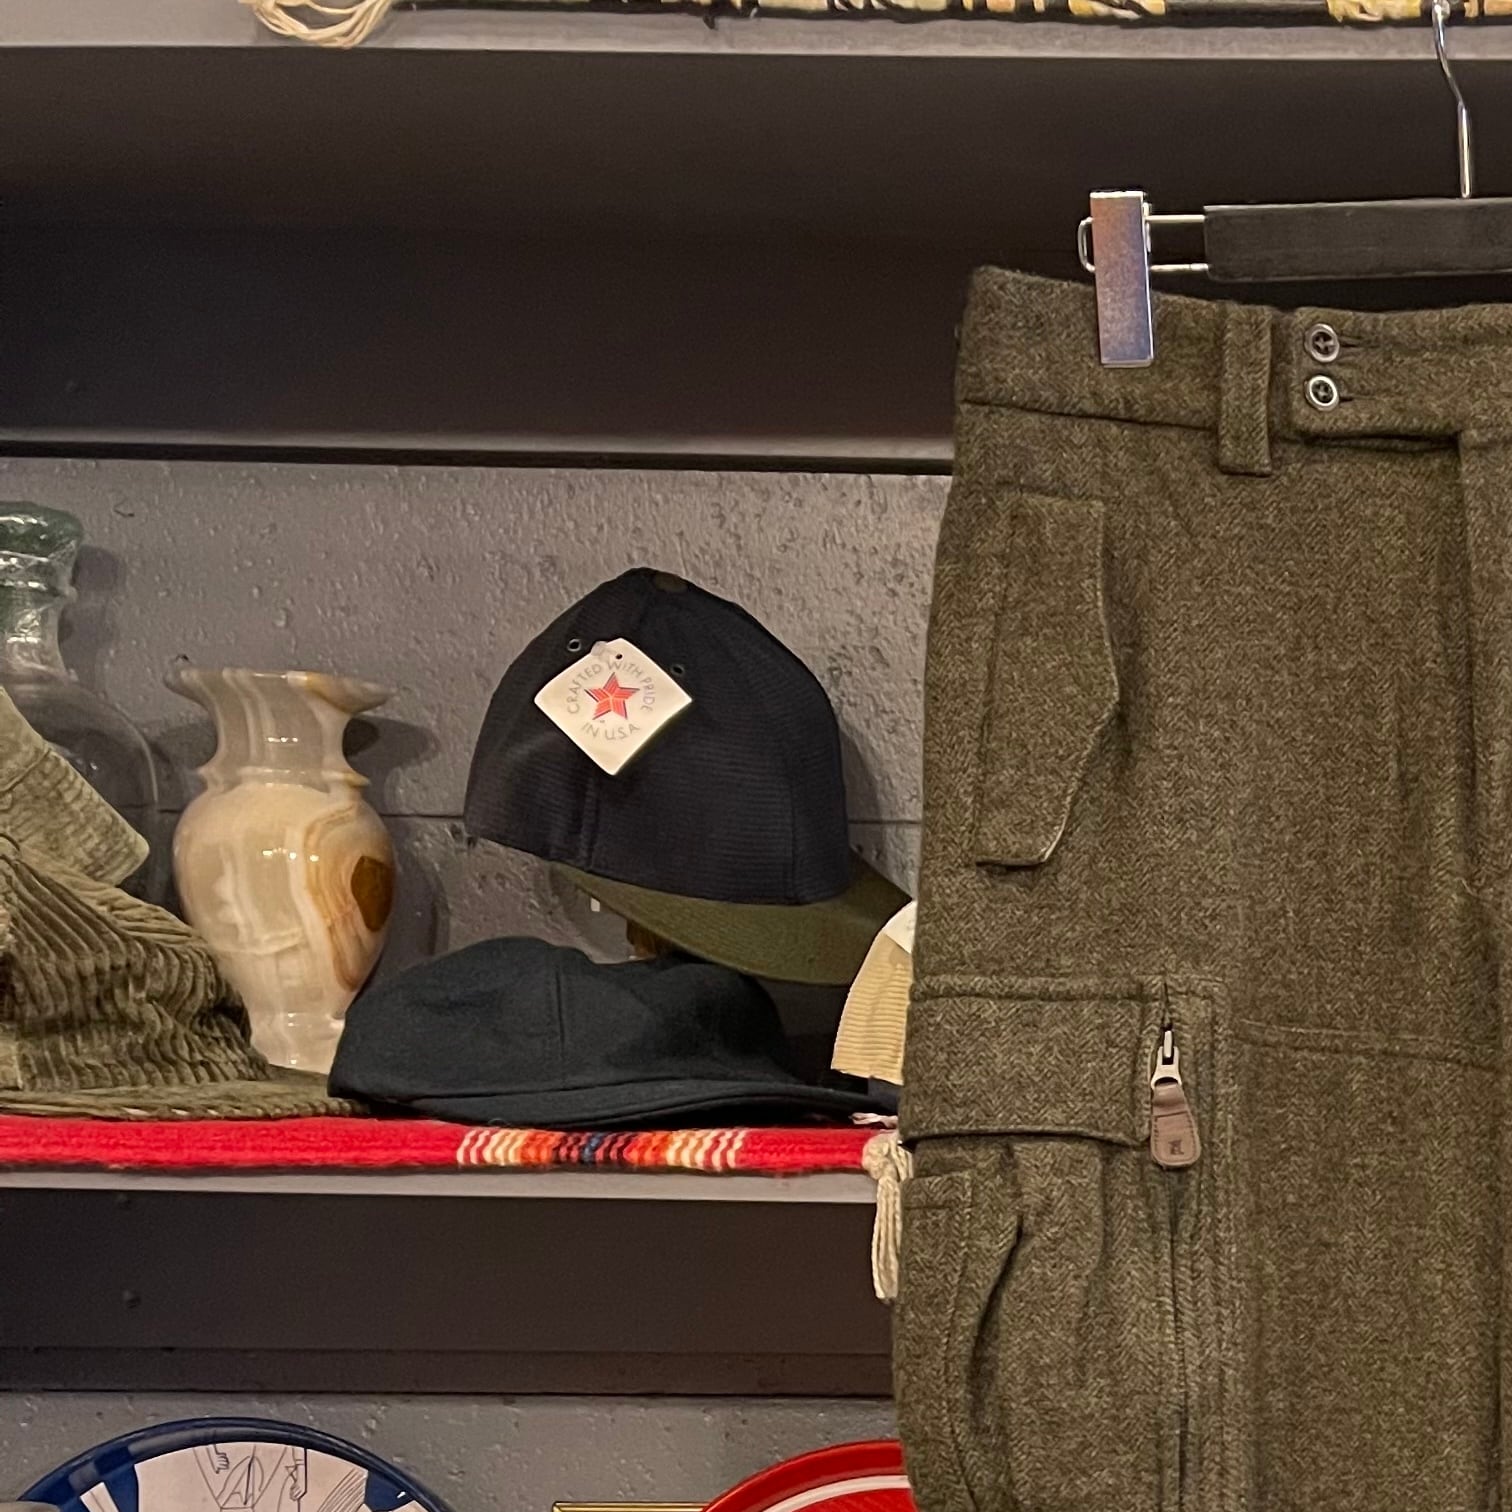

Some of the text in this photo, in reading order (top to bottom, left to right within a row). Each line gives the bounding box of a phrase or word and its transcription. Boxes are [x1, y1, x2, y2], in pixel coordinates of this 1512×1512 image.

[566, 658, 657, 714] CRAFTED WITH PRIDE
[581, 722, 600, 738] IN
